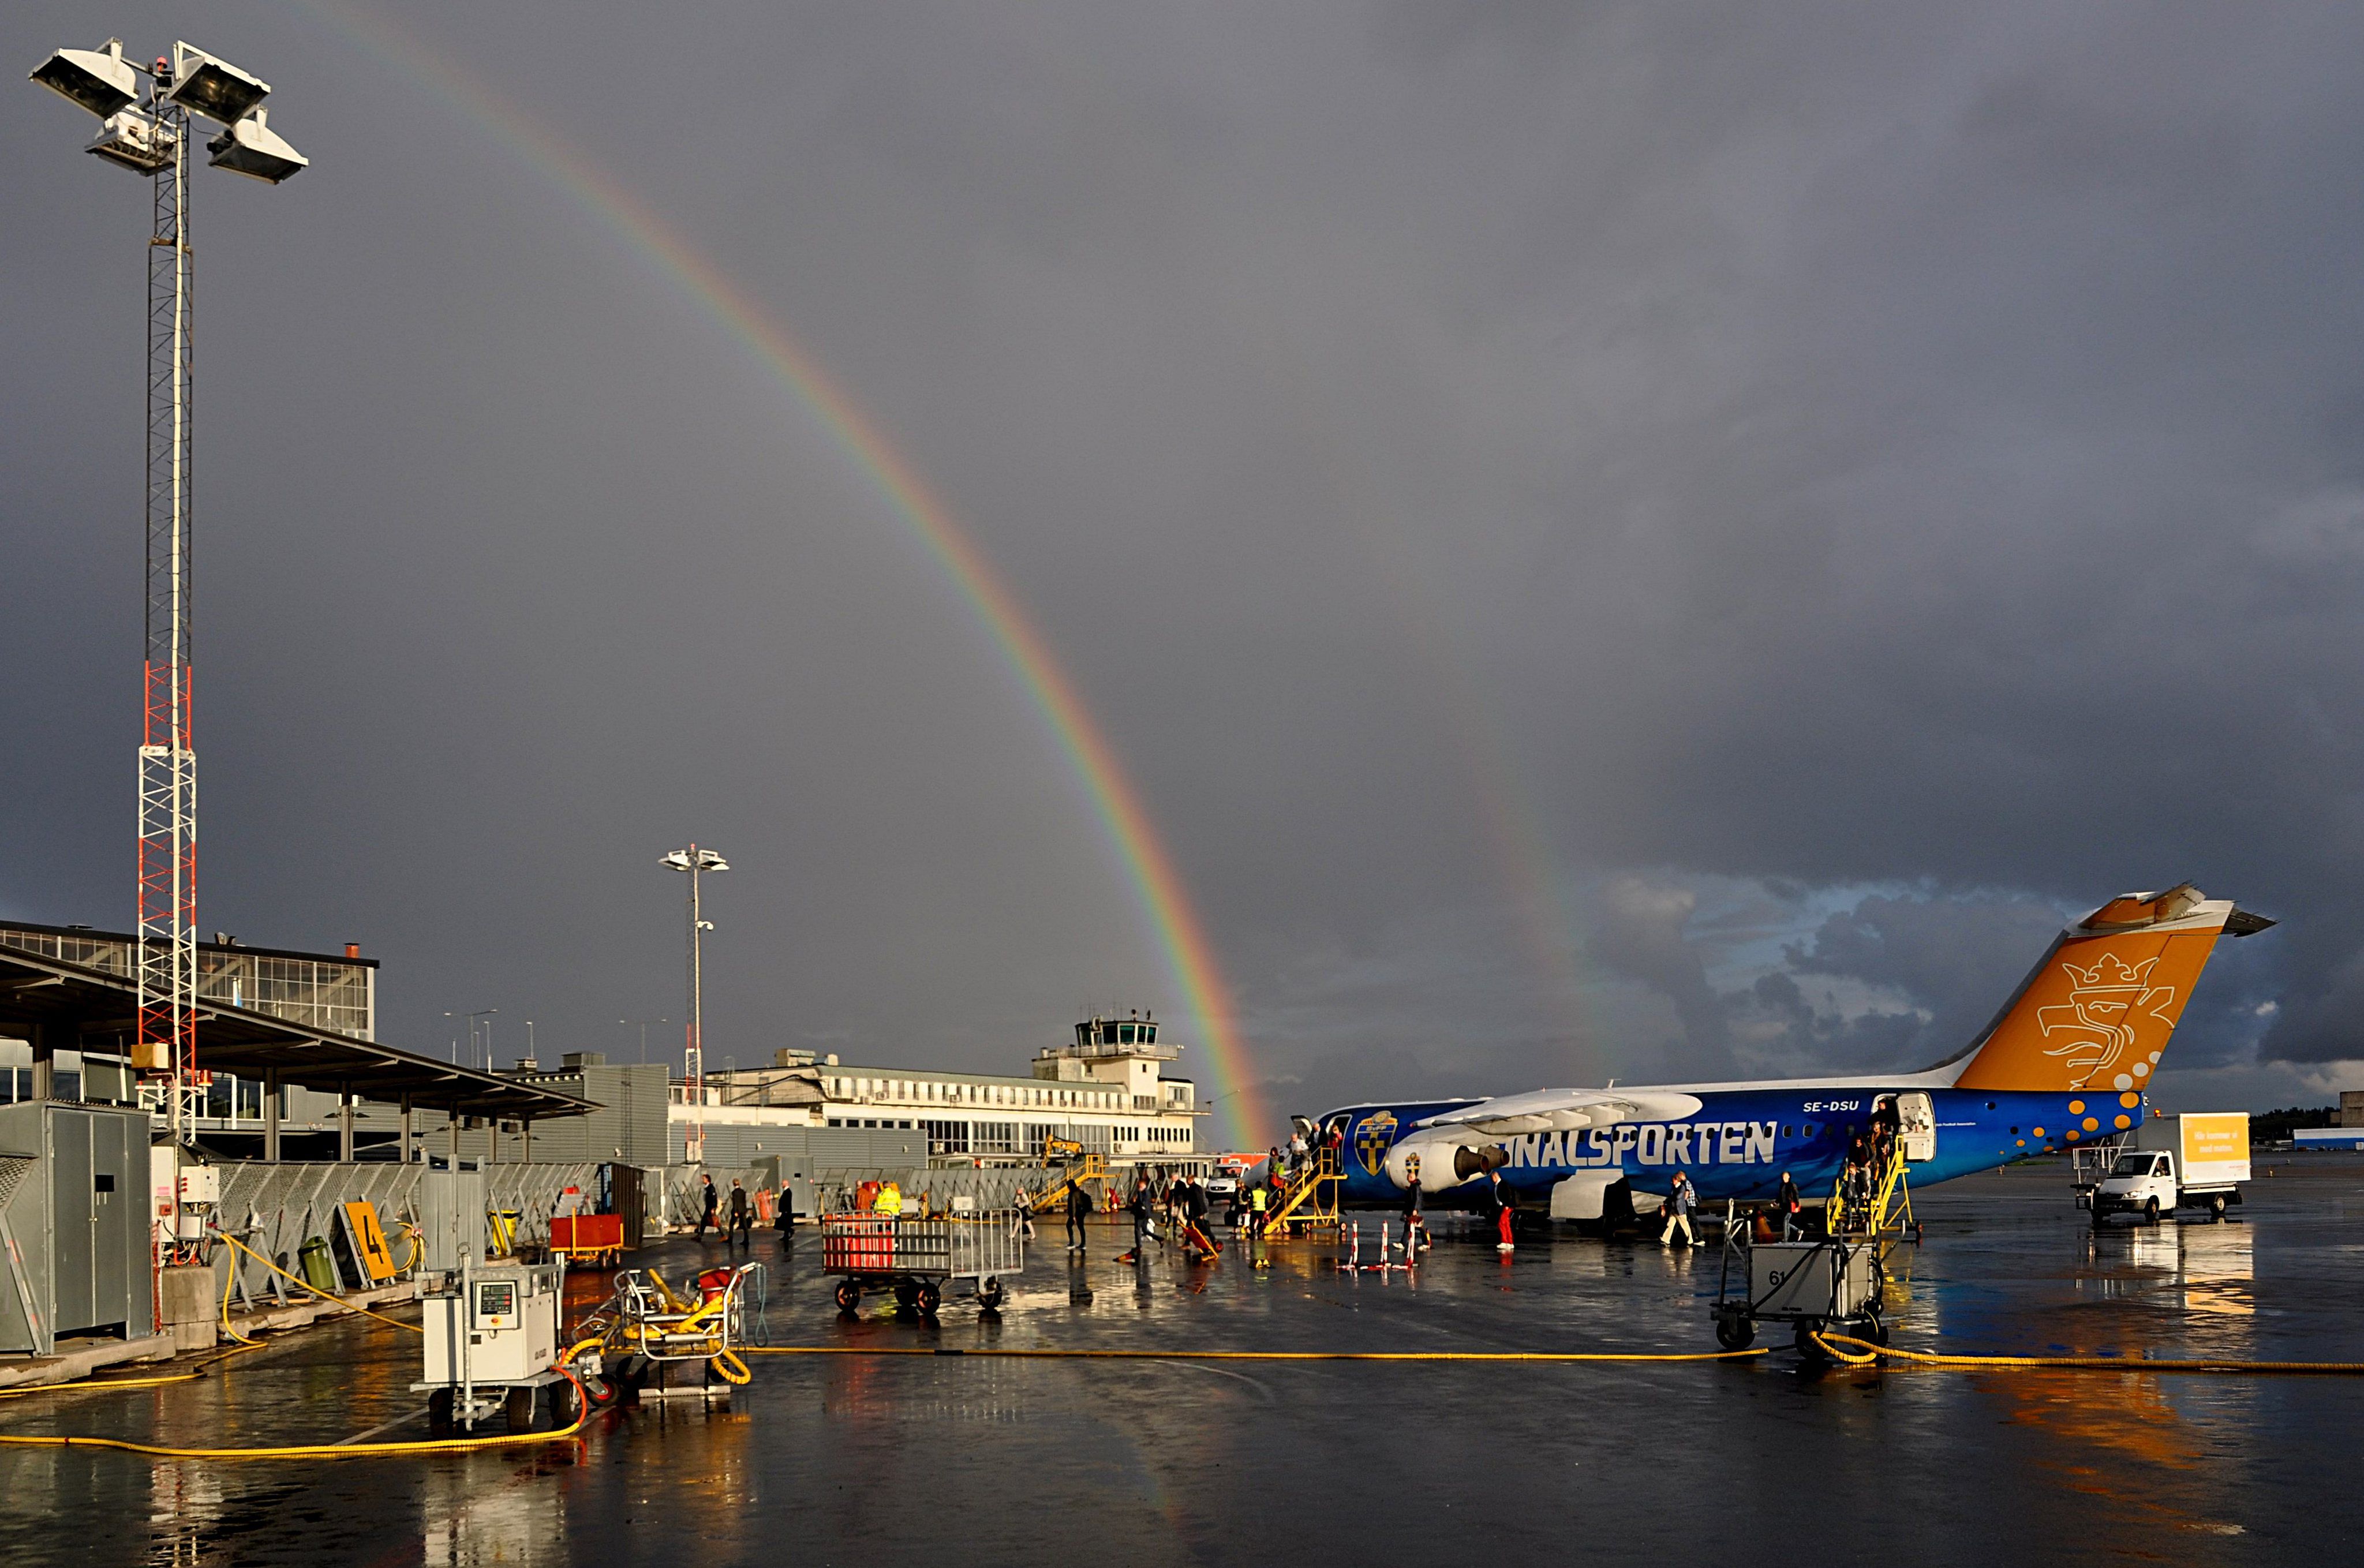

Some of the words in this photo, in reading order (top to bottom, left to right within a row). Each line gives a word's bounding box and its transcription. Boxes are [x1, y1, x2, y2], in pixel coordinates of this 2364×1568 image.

[1803, 1101, 1859, 1112] SE-DSU
[363, 1215, 384, 1264] 4
[1769, 1271, 1786, 1286] 61
